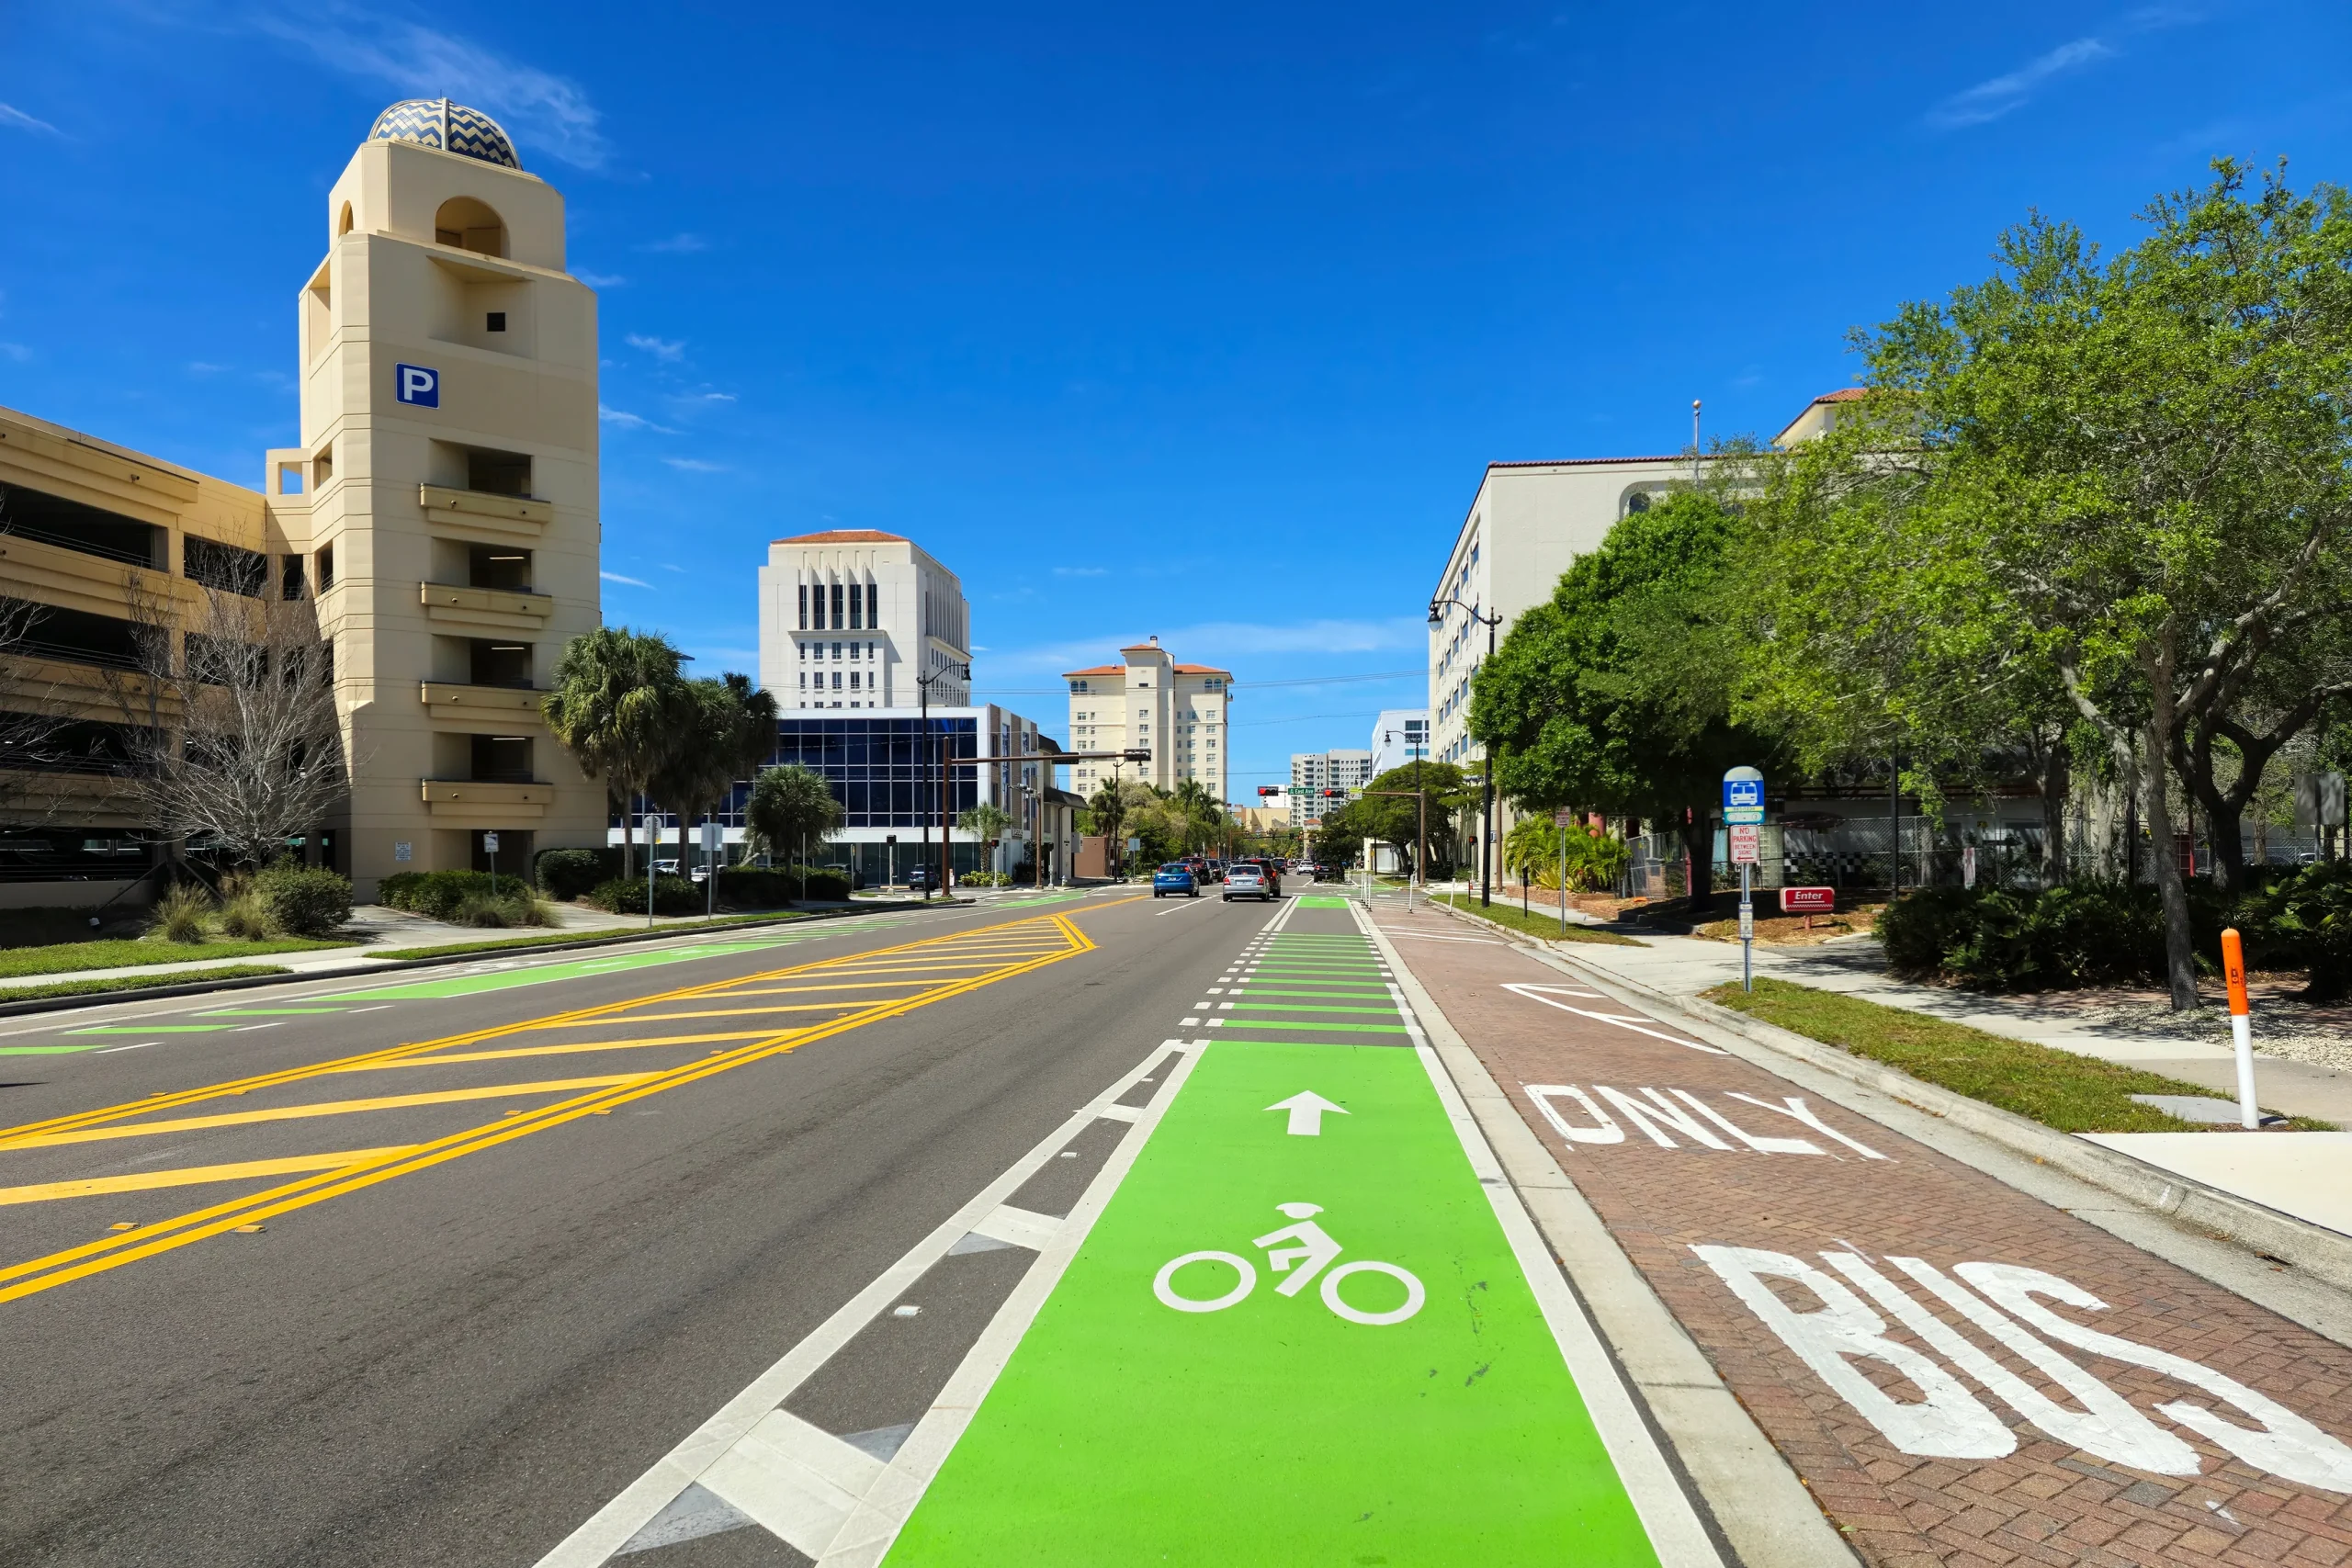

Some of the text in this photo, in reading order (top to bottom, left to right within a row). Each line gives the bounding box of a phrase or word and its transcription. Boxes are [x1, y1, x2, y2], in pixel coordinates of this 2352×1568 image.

[404, 367, 434, 400] P
[1794, 891, 1824, 900] Enter
[1523, 1084, 1893, 1161] ONLY
[1687, 1244, 2352, 1495] BUS
